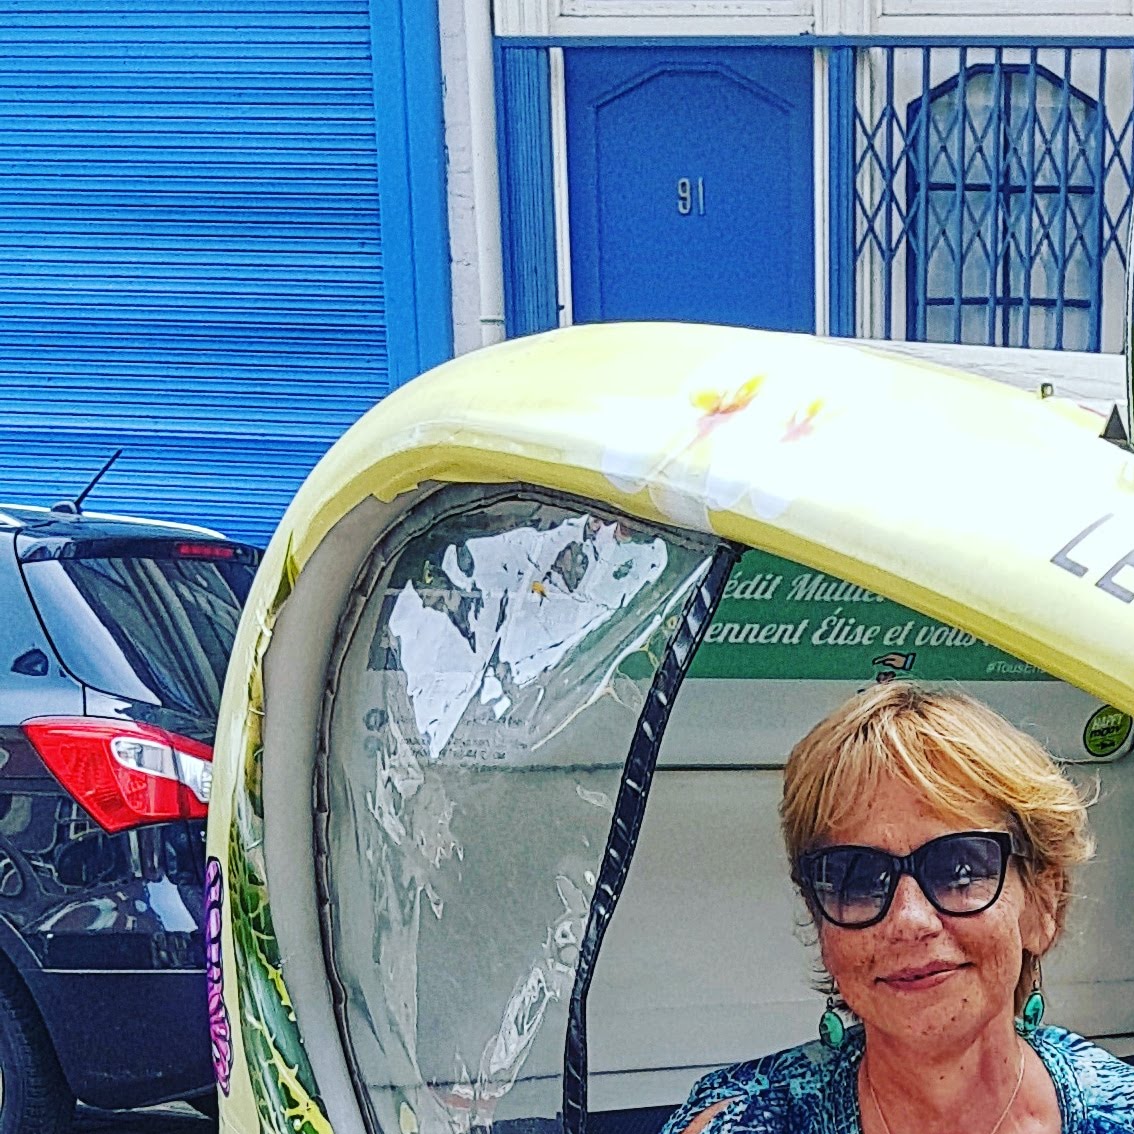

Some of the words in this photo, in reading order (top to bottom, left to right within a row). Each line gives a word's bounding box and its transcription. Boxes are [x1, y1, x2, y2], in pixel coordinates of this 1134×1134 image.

[677, 176, 706, 216] 91
[722, 570, 783, 600] édit
[702, 618, 810, 645] ennent
[811, 606, 881, 646] Élise
[882, 620, 916, 647] et
